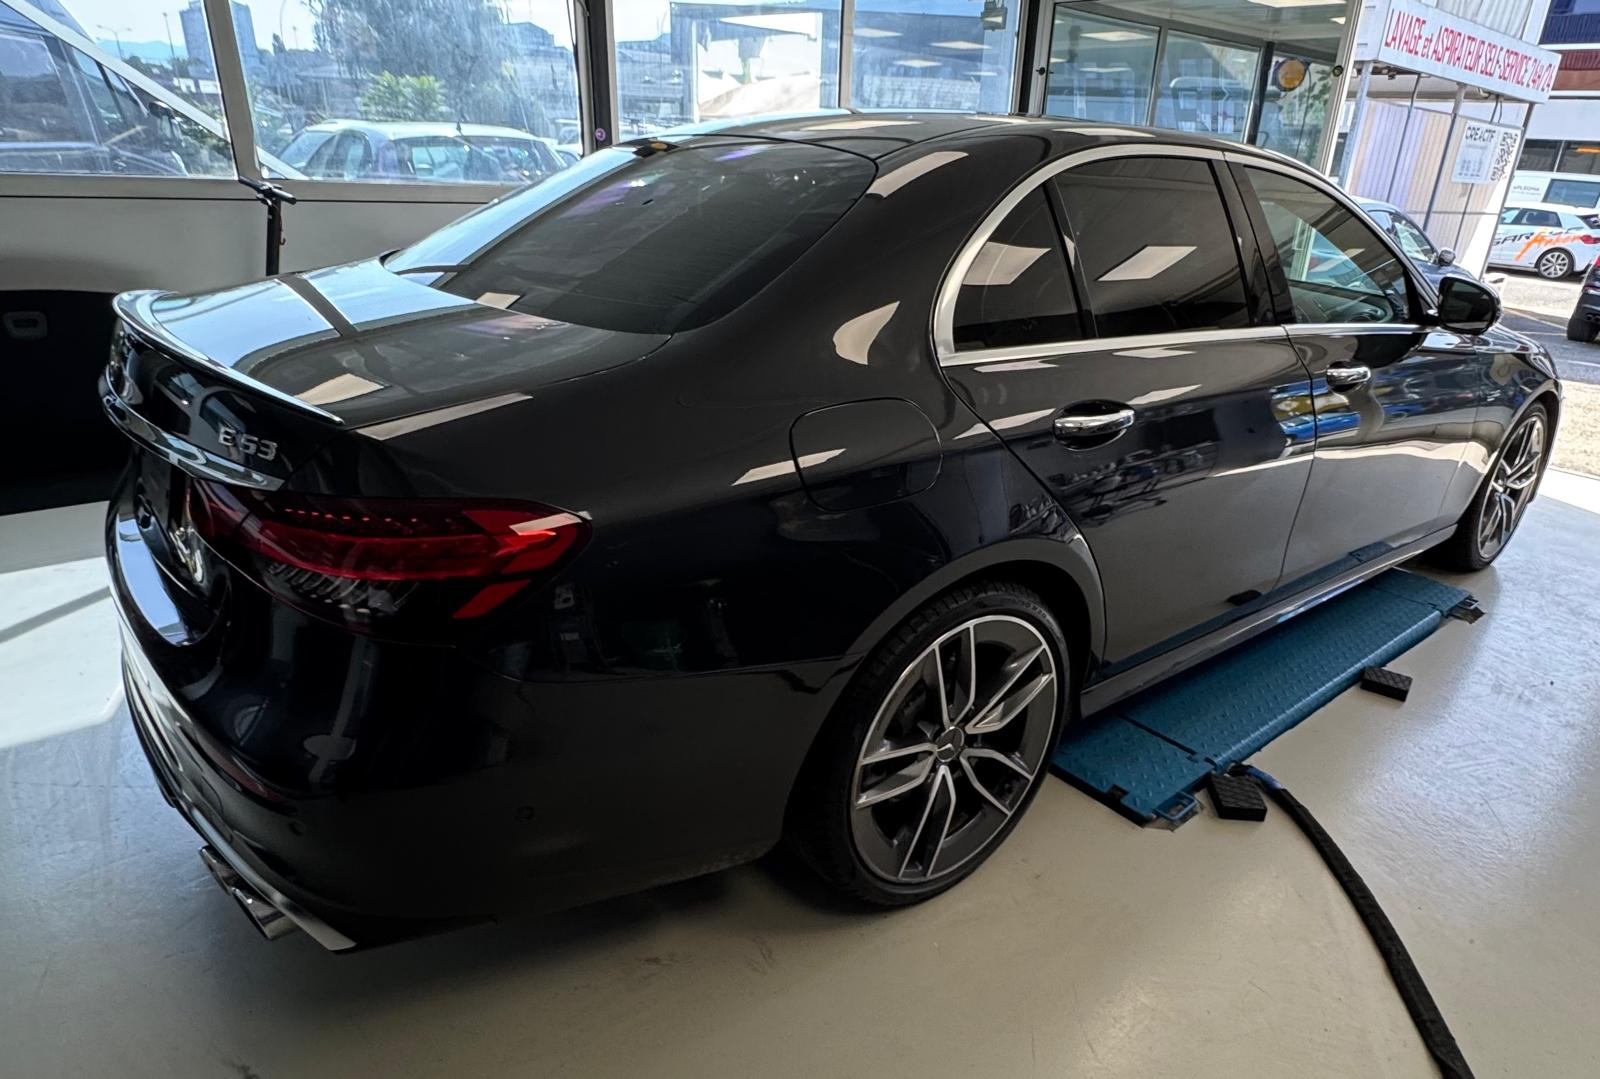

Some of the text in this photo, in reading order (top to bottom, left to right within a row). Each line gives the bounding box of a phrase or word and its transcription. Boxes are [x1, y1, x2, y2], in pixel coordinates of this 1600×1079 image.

[1384, 8, 1426, 56] LAVAGE
[1421, 33, 1434, 59] et
[1430, 25, 1486, 74] ASPIRATEUR
[218, 426, 279, 461] E 53
